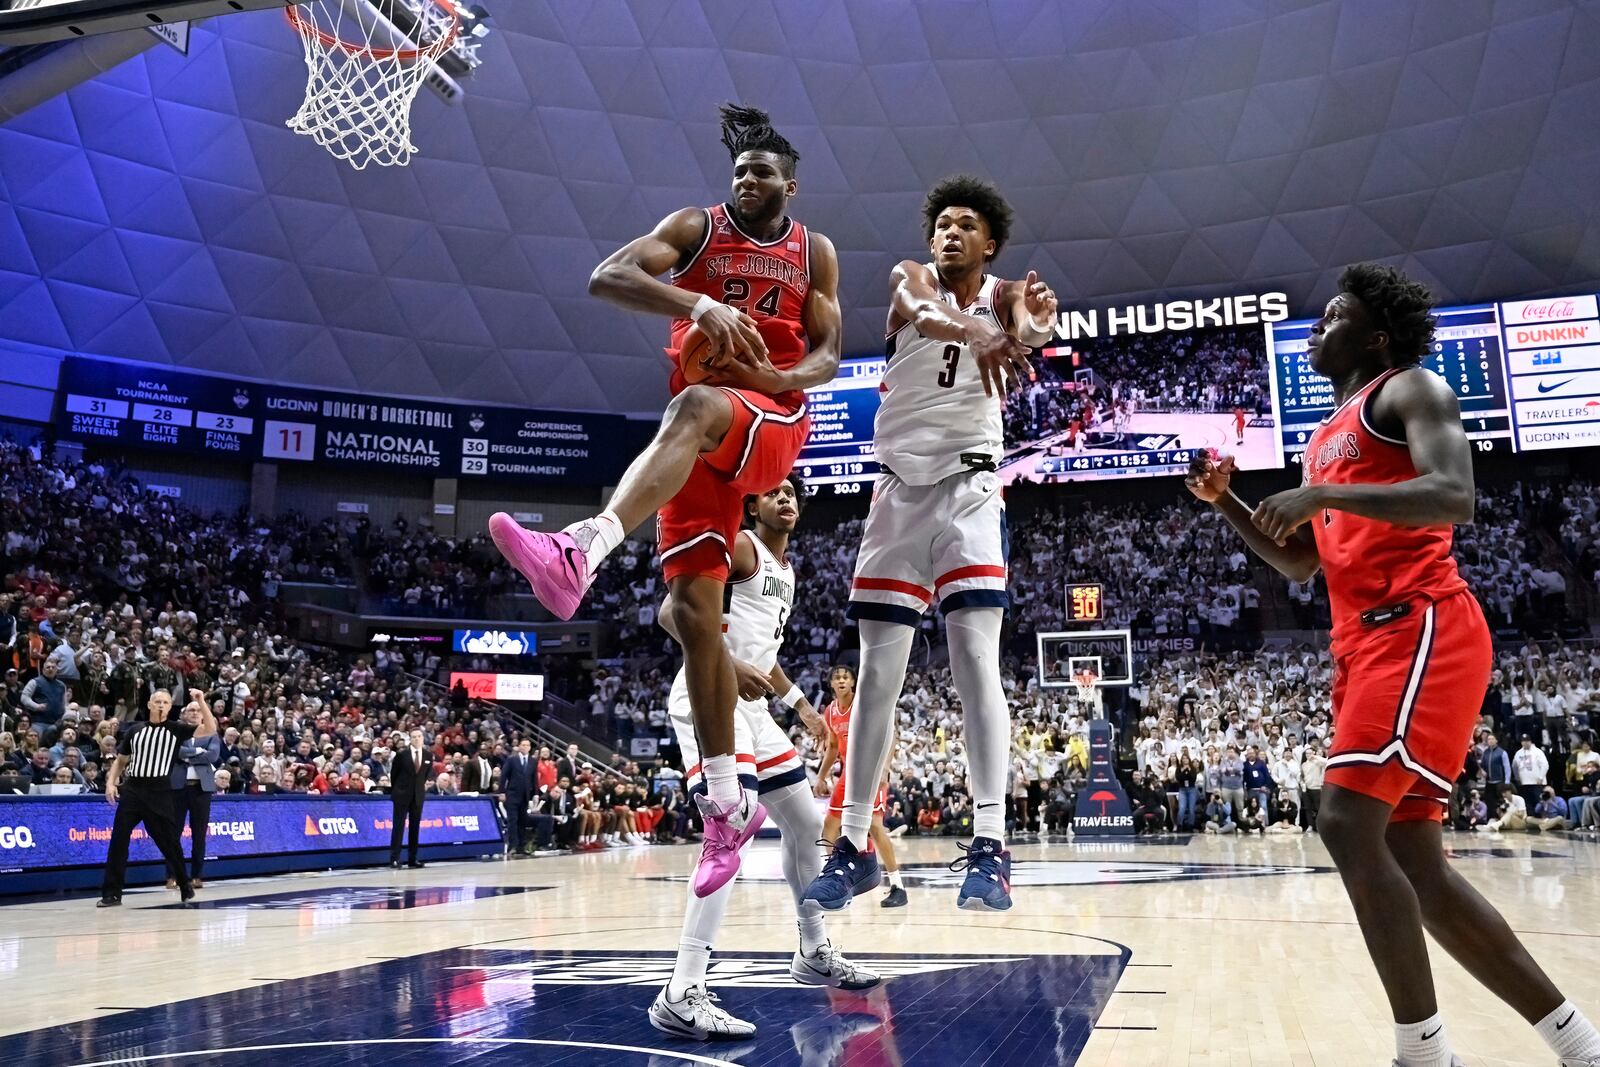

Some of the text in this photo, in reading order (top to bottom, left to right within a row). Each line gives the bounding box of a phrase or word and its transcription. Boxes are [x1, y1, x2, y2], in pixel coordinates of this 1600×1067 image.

[706, 254, 808, 293] ST. JOHN'S
[722, 278, 782, 317] 24
[1107, 292, 1288, 336] HUSKIES
[1516, 326, 1589, 343] DUNKIN'
[1434, 339, 1485, 351] 0 3 1
[1282, 355, 1291, 364] 0
[1435, 350, 1487, 362] 4 2 2
[937, 344, 961, 389] 3
[1284, 366, 1290, 374] 1
[1460, 362, 1466, 372] 1
[1480, 360, 1489, 370] 0
[1460, 373, 1469, 383] 2
[1483, 371, 1489, 381] 1
[138, 380, 168, 391] NCAA
[1285, 386, 1293, 396] 7
[1461, 382, 1490, 394] 0 1
[116, 387, 189, 404] TOURNAMENT
[90, 400, 106, 412] 31
[1283, 398, 1297, 406] 24
[153, 409, 172, 421] 28
[266, 397, 454, 428] UCONN WOMEN'S BASKETBALL
[1526, 407, 1589, 420] TRAVELERS
[73, 415, 120, 429] SWEET
[216, 417, 234, 429] 23
[524, 421, 583, 432] CONFERENCE
[1478, 419, 1486, 430] 1
[71, 424, 118, 437] SIXTEENS
[144, 423, 178, 436] ELITE
[517, 429, 589, 441] CHAMPIONSHIPS
[143, 433, 178, 444] EIGHTS
[205, 431, 240, 443] FINAL
[278, 429, 302, 452] 11
[326, 430, 441, 456] NATIONAL
[1297, 432, 1306, 443] 9
[1525, 432, 1570, 443] UCONN
[205, 440, 240, 451] FOURS
[467, 440, 589, 459] 30 REGULAR SEASON
[1476, 440, 1493, 451] 10
[325, 447, 441, 467] CHAMPIONSHIPS
[1072, 451, 1190, 469] 42 15:52 42
[466, 460, 567, 476] 29 TOURNAMENT
[803, 467, 812, 477] 9
[830, 465, 843, 475] 12
[850, 463, 863, 473] 19
[1072, 587, 1099, 599] 15:52
[1074, 599, 1097, 618] 30
[774, 606, 786, 640] 5
[501, 681, 539, 689] PROBLEM
[1073, 815, 1134, 828] TRAVELERS
[69, 827, 86, 841] Our
